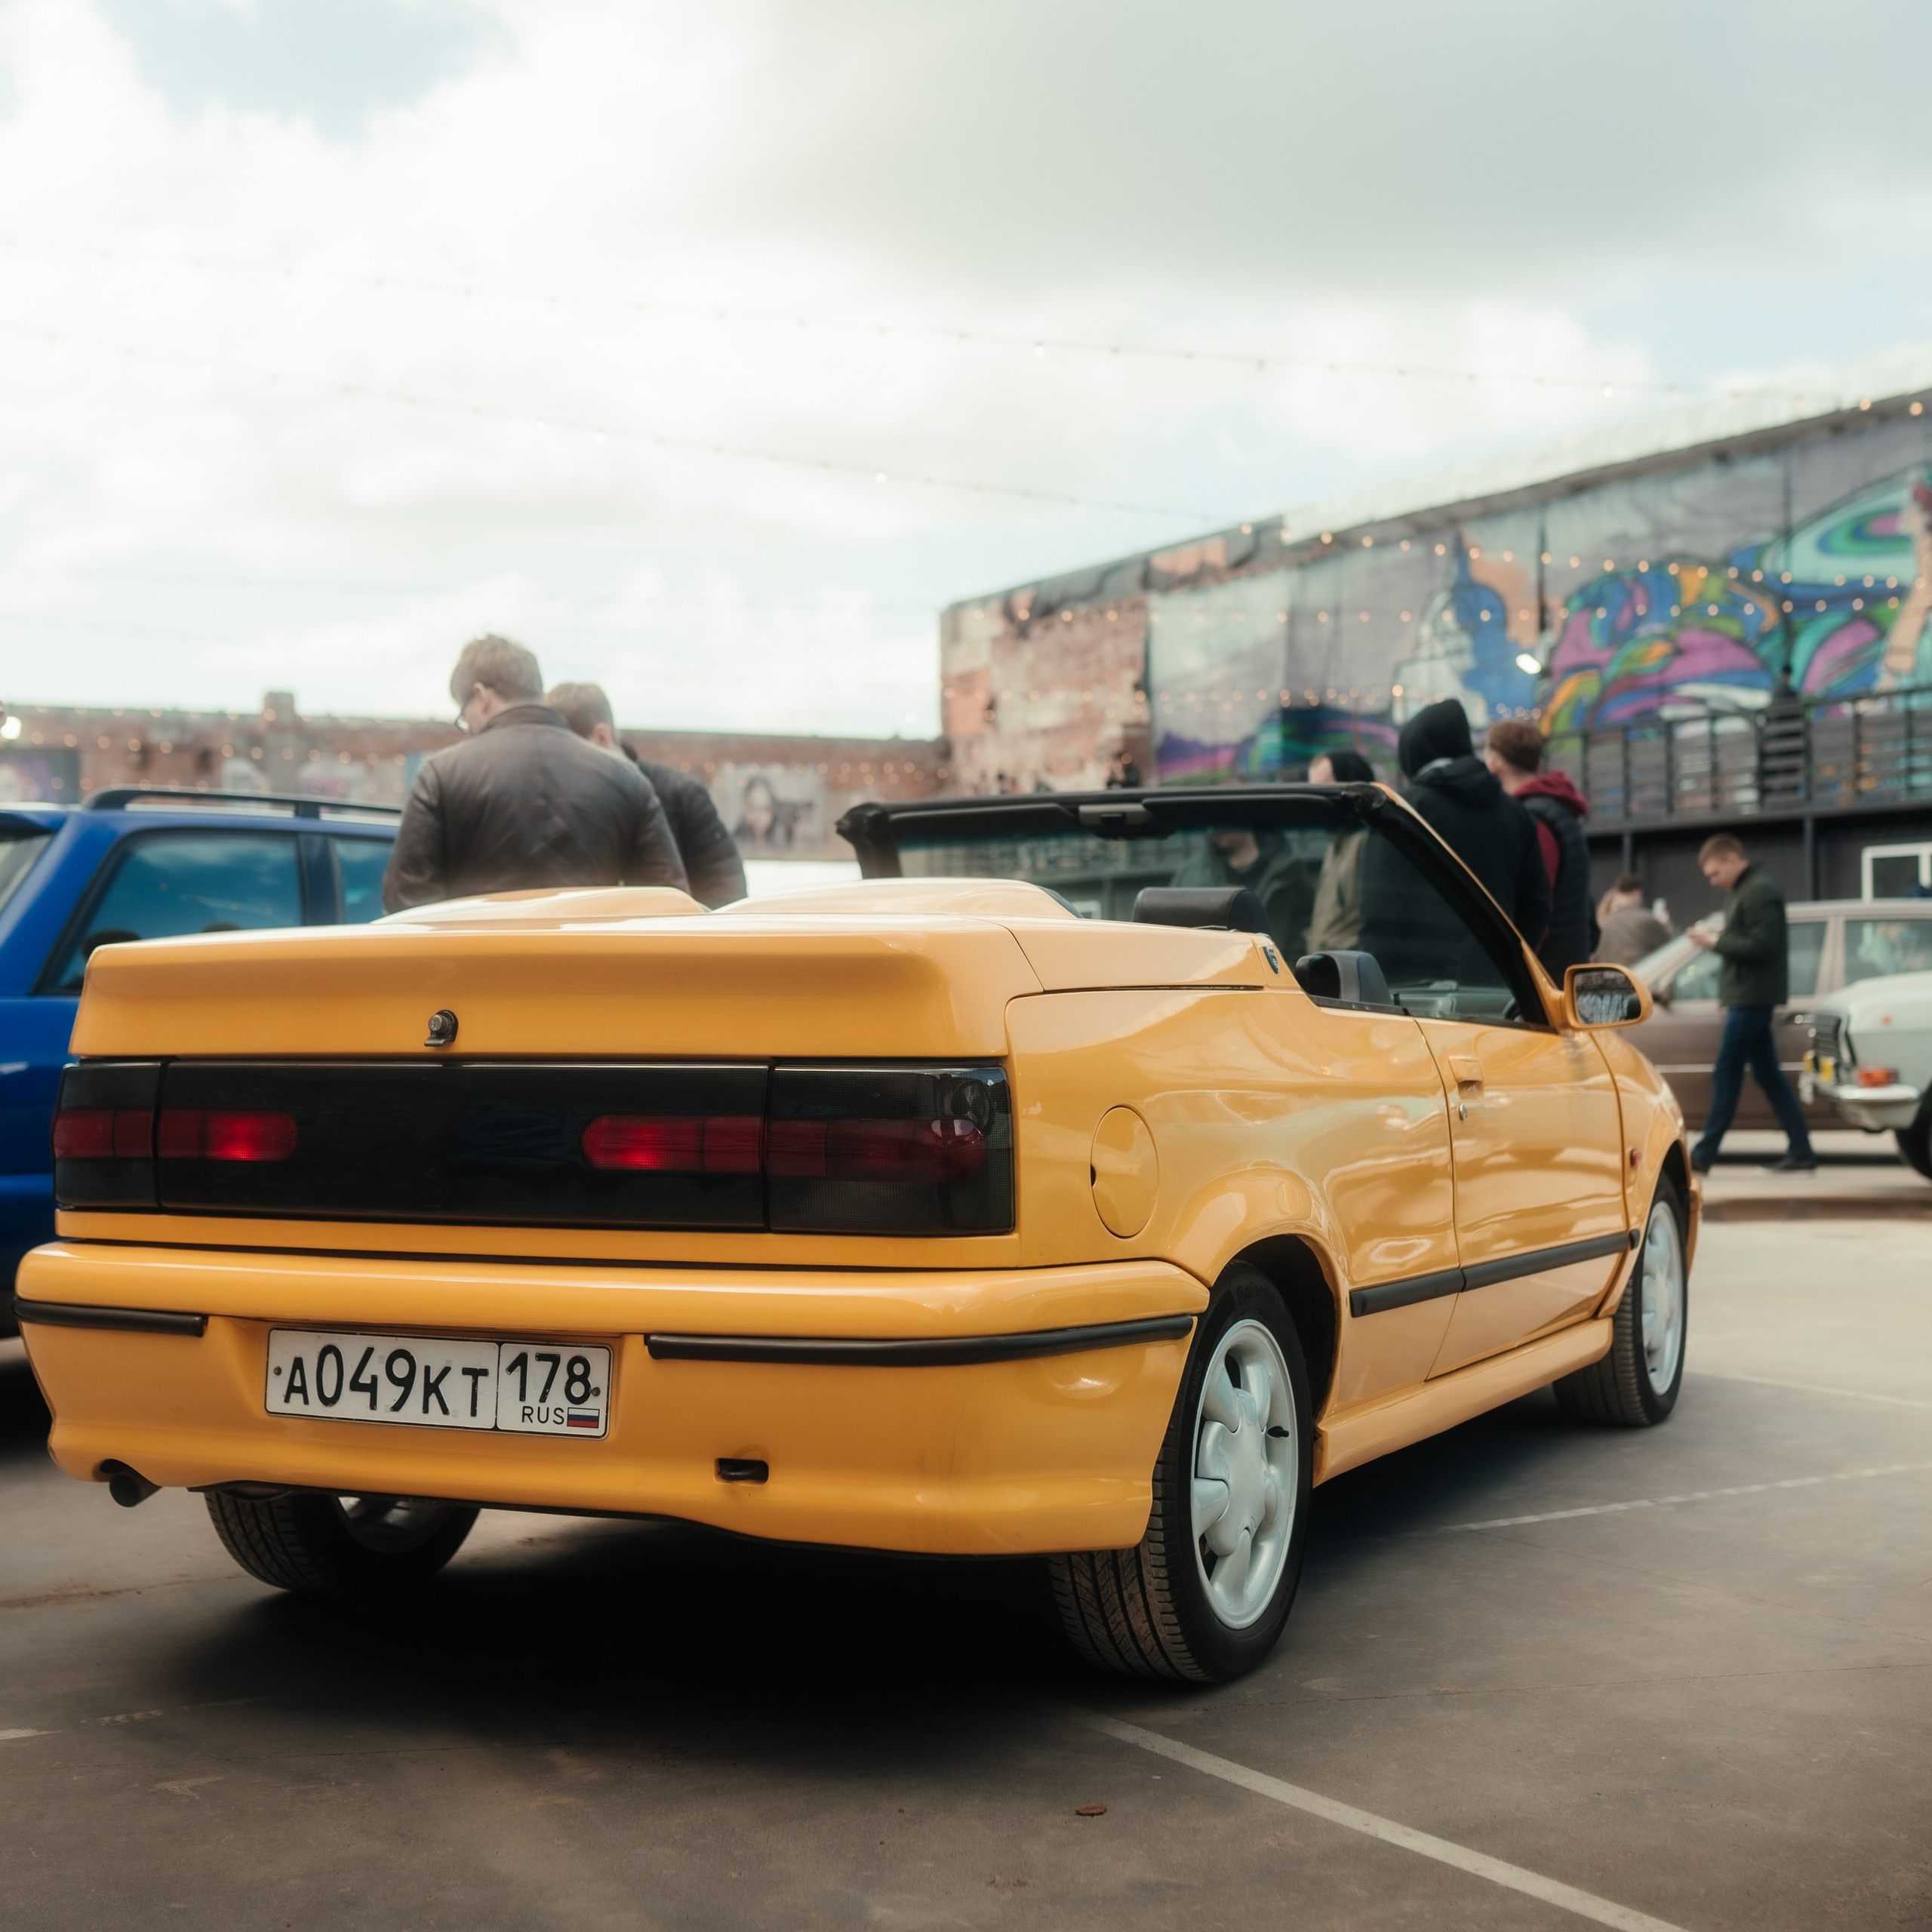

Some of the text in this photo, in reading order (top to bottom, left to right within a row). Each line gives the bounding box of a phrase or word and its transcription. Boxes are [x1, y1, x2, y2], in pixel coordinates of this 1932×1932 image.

[506, 1352, 592, 1404] 178
[1189, 1358, 1204, 1404] INSIDE
[522, 1406, 565, 1425] RUS
